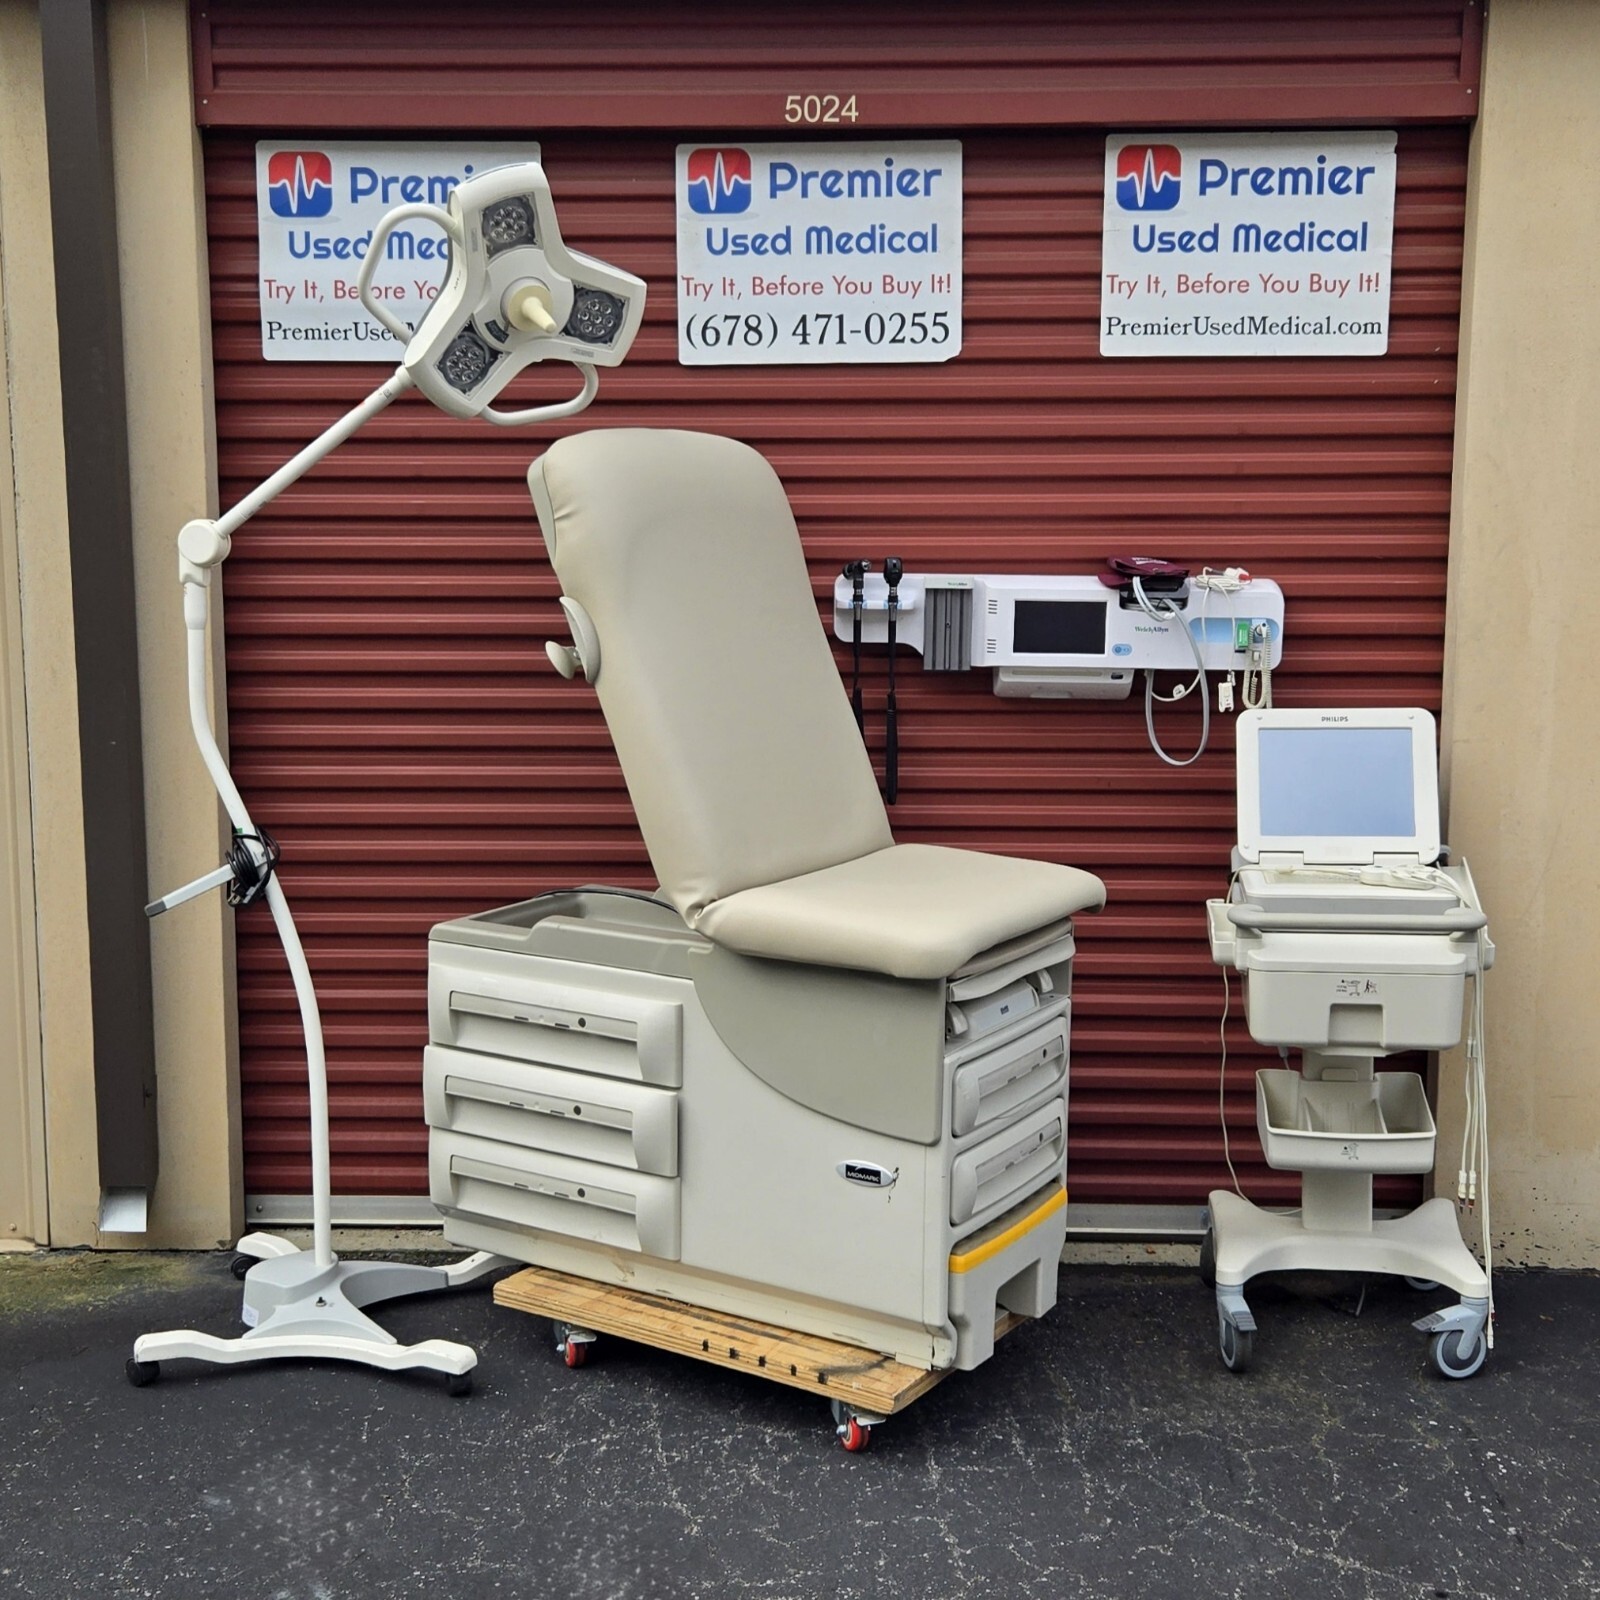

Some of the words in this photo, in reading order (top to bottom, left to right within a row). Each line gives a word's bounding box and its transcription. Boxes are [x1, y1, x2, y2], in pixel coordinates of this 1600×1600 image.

[785, 95, 859, 123] 5024
[350, 164, 474, 204] Prem
[769, 157, 942, 199] Premier
[1199, 155, 1375, 196] Premier
[706, 226, 792, 256] Used
[806, 223, 938, 255] Medical
[1133, 223, 1219, 253] Used
[1232, 222, 1368, 253] Medical
[264, 279, 296, 304] Try
[304, 280, 325, 303] It,
[334, 280, 406, 299] Beore
[681, 275, 713, 301] Try
[722, 277, 741, 300] It,
[753, 275, 824, 295] Before
[832, 275, 872, 294] You
[883, 275, 922, 299] Buy
[931, 273, 951, 293] It!
[1106, 274, 1138, 299] Try
[1146, 274, 1167, 298] It,
[1177, 273, 1249, 293] Before
[1259, 274, 1298, 293] You
[1309, 274, 1350, 298] Buy
[1359, 272, 1379, 292] It!
[686, 313, 778, 348] (678)
[792, 311, 950, 345] 471-0255
[1106, 316, 1382, 336] PremierUsedMedical.com
[847, 1171, 880, 1183] MIDMARK
